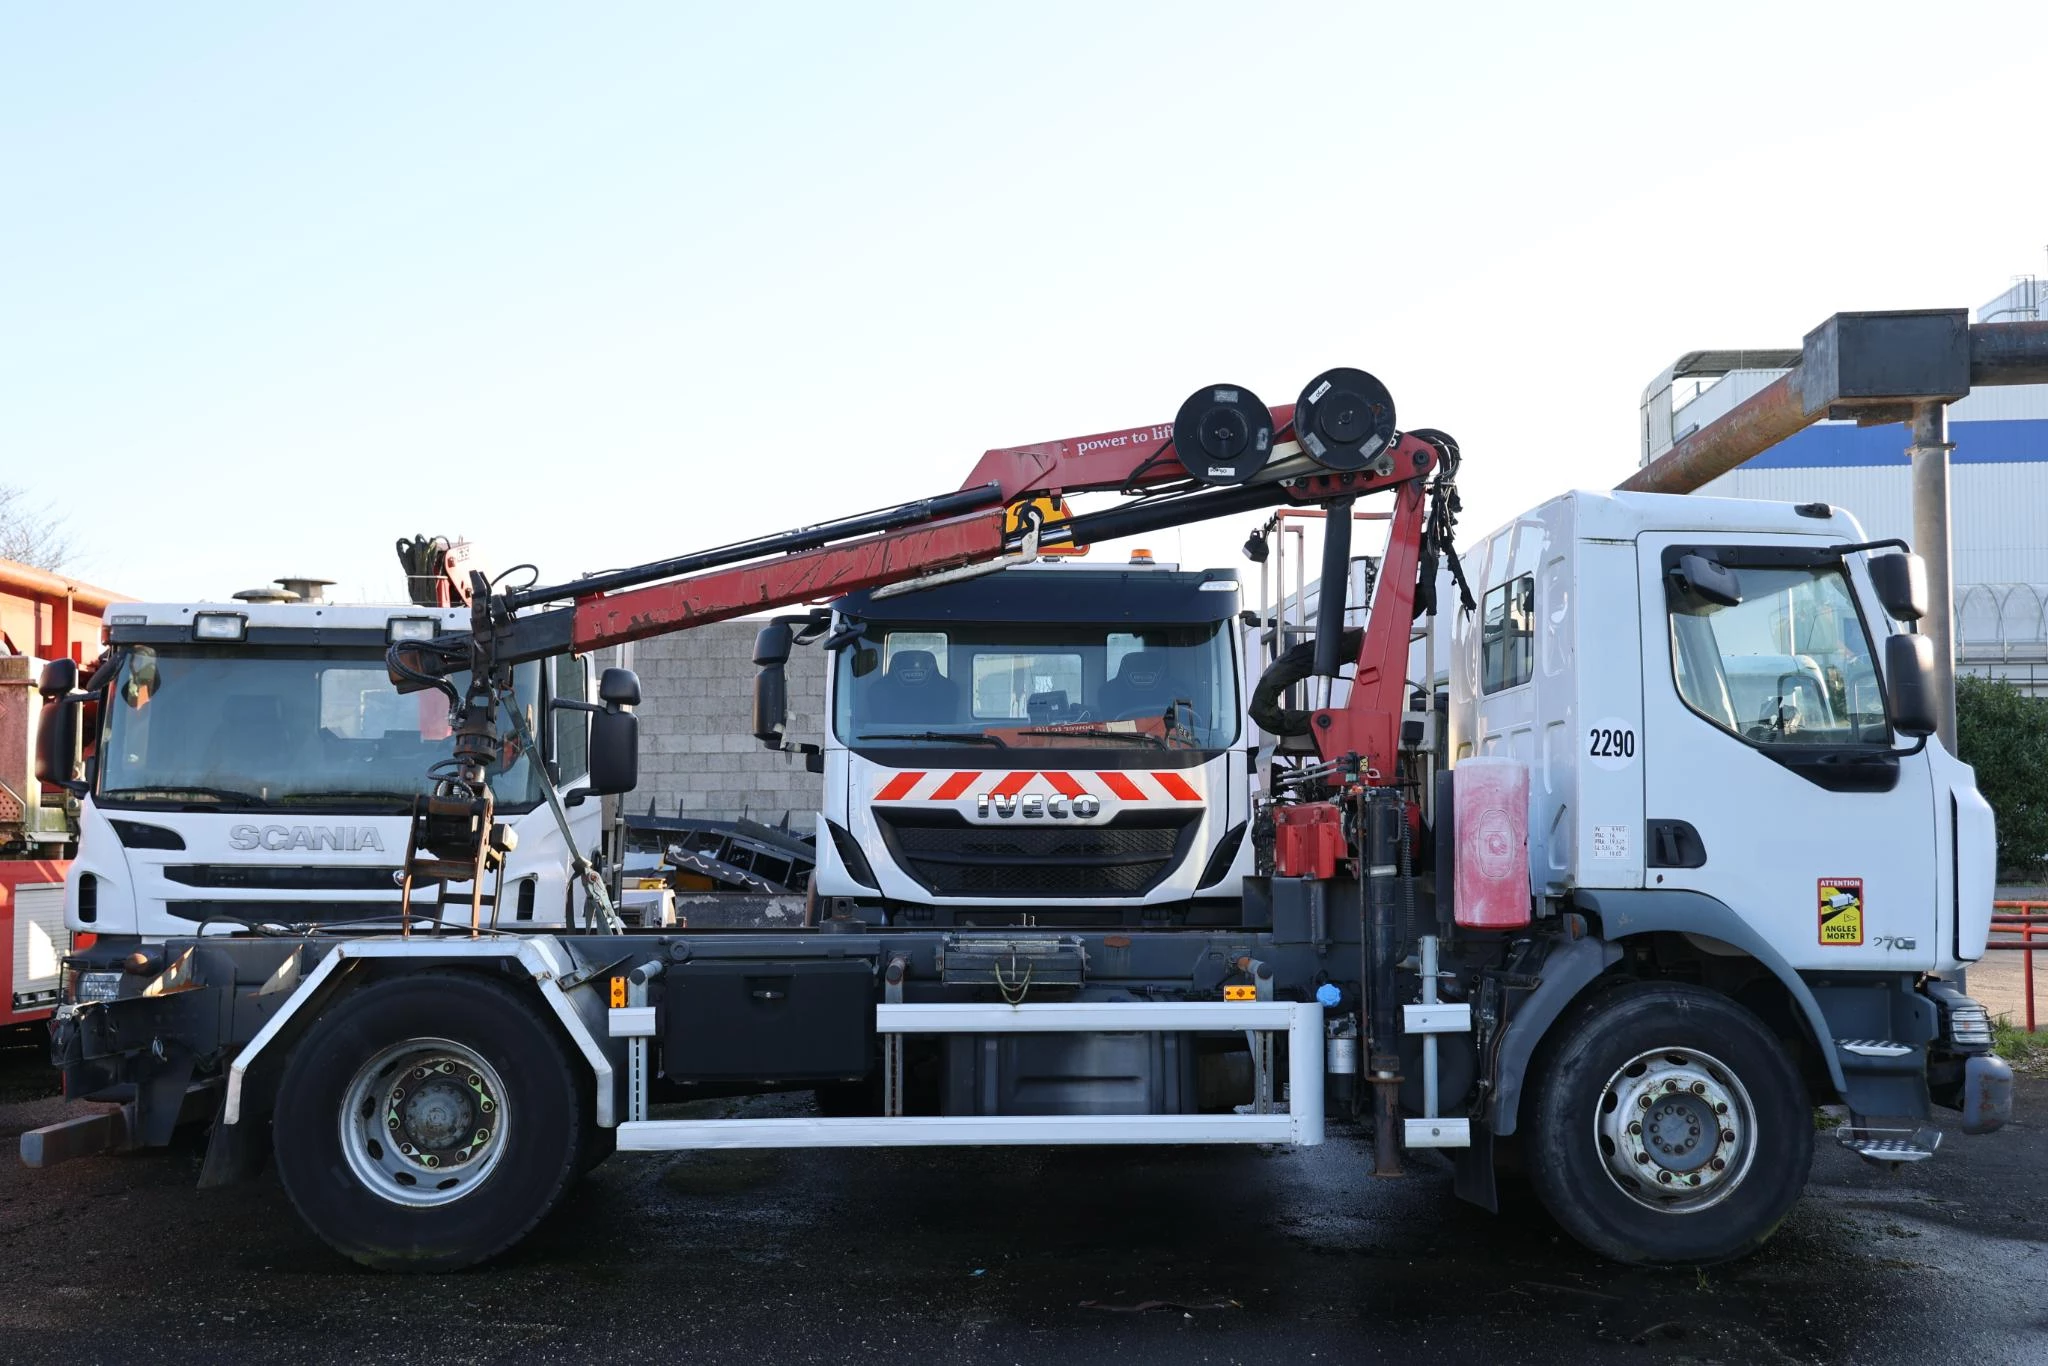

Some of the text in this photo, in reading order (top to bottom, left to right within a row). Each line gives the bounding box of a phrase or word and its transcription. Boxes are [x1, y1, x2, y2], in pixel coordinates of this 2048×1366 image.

[1077, 436, 1128, 456] power
[1132, 432, 1148, 444] to
[1590, 729, 1635, 757] 2290
[977, 793, 1100, 819] IVECO
[229, 824, 384, 852] SCANIA
[1825, 925, 1857, 933] ANGLES
